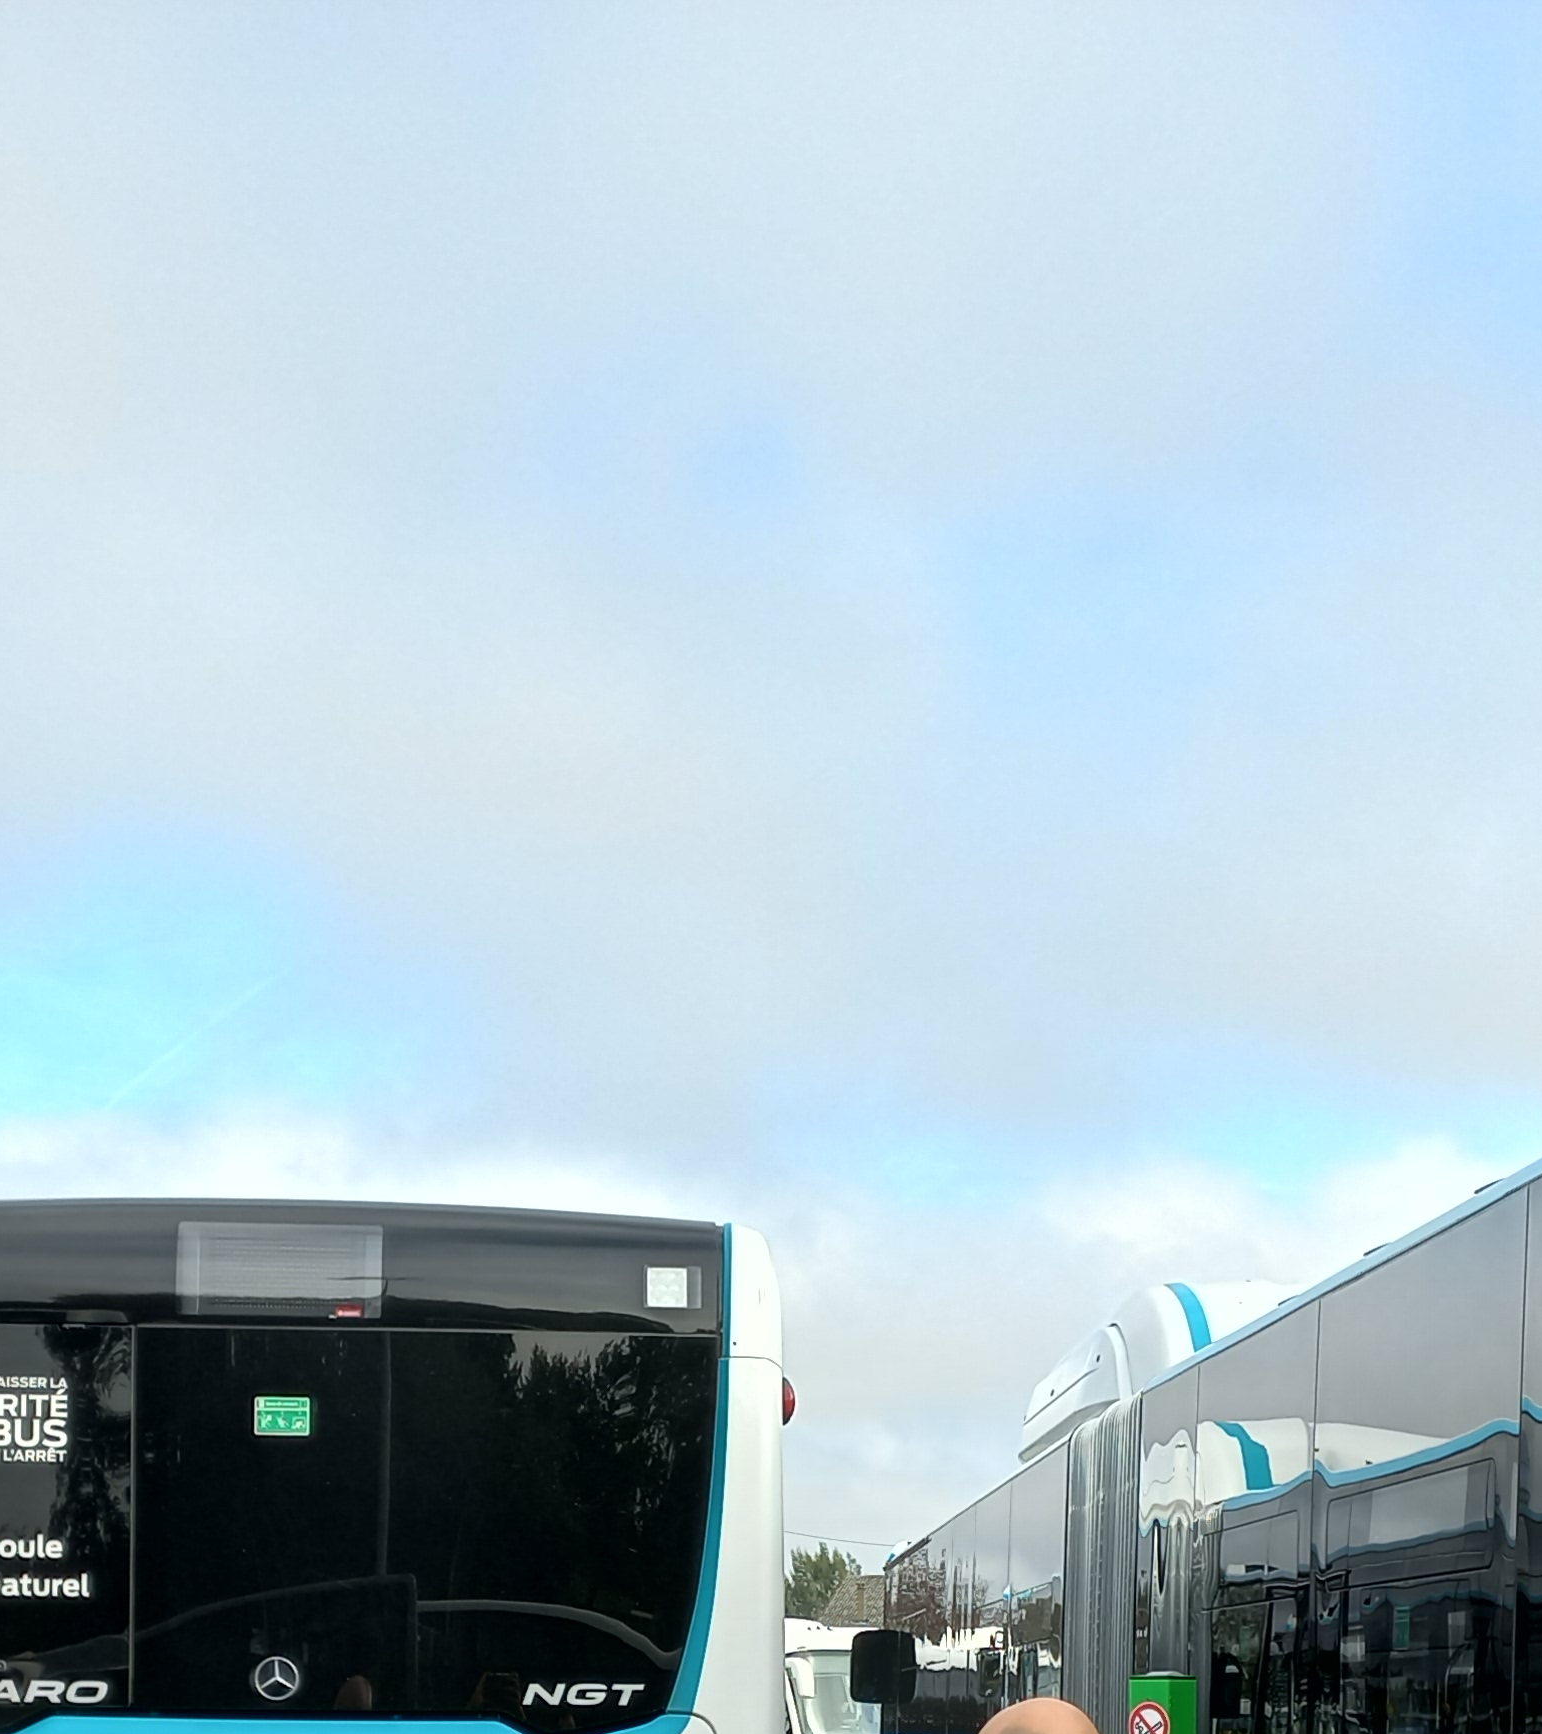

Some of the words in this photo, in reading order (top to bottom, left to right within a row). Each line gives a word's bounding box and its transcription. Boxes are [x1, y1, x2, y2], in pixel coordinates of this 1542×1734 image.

[50, 1377, 68, 1389] LA
[3, 1447, 68, 1463] L'ARRÊT
[522, 1683, 646, 1706] NGT
